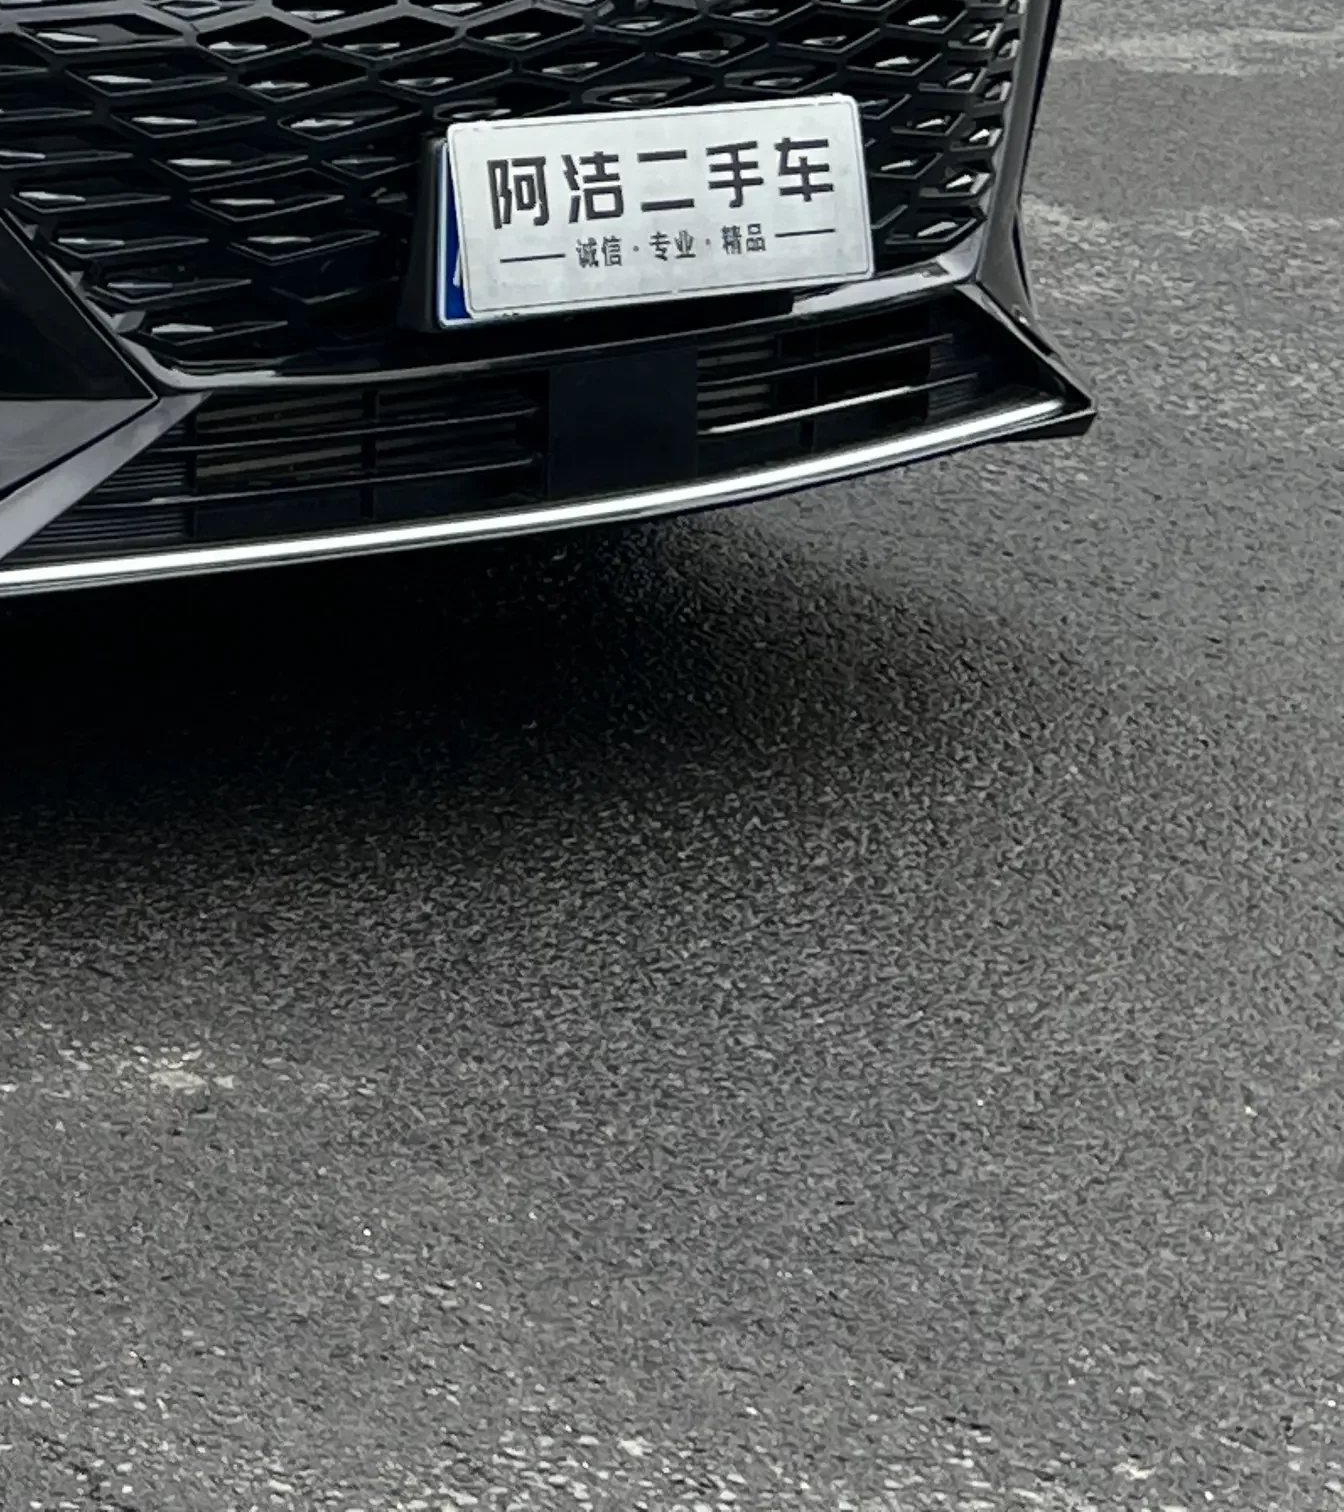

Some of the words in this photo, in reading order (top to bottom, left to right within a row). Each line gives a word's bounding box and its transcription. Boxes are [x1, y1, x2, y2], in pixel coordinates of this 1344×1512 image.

[486, 136, 835, 230] 阿洁二手车
